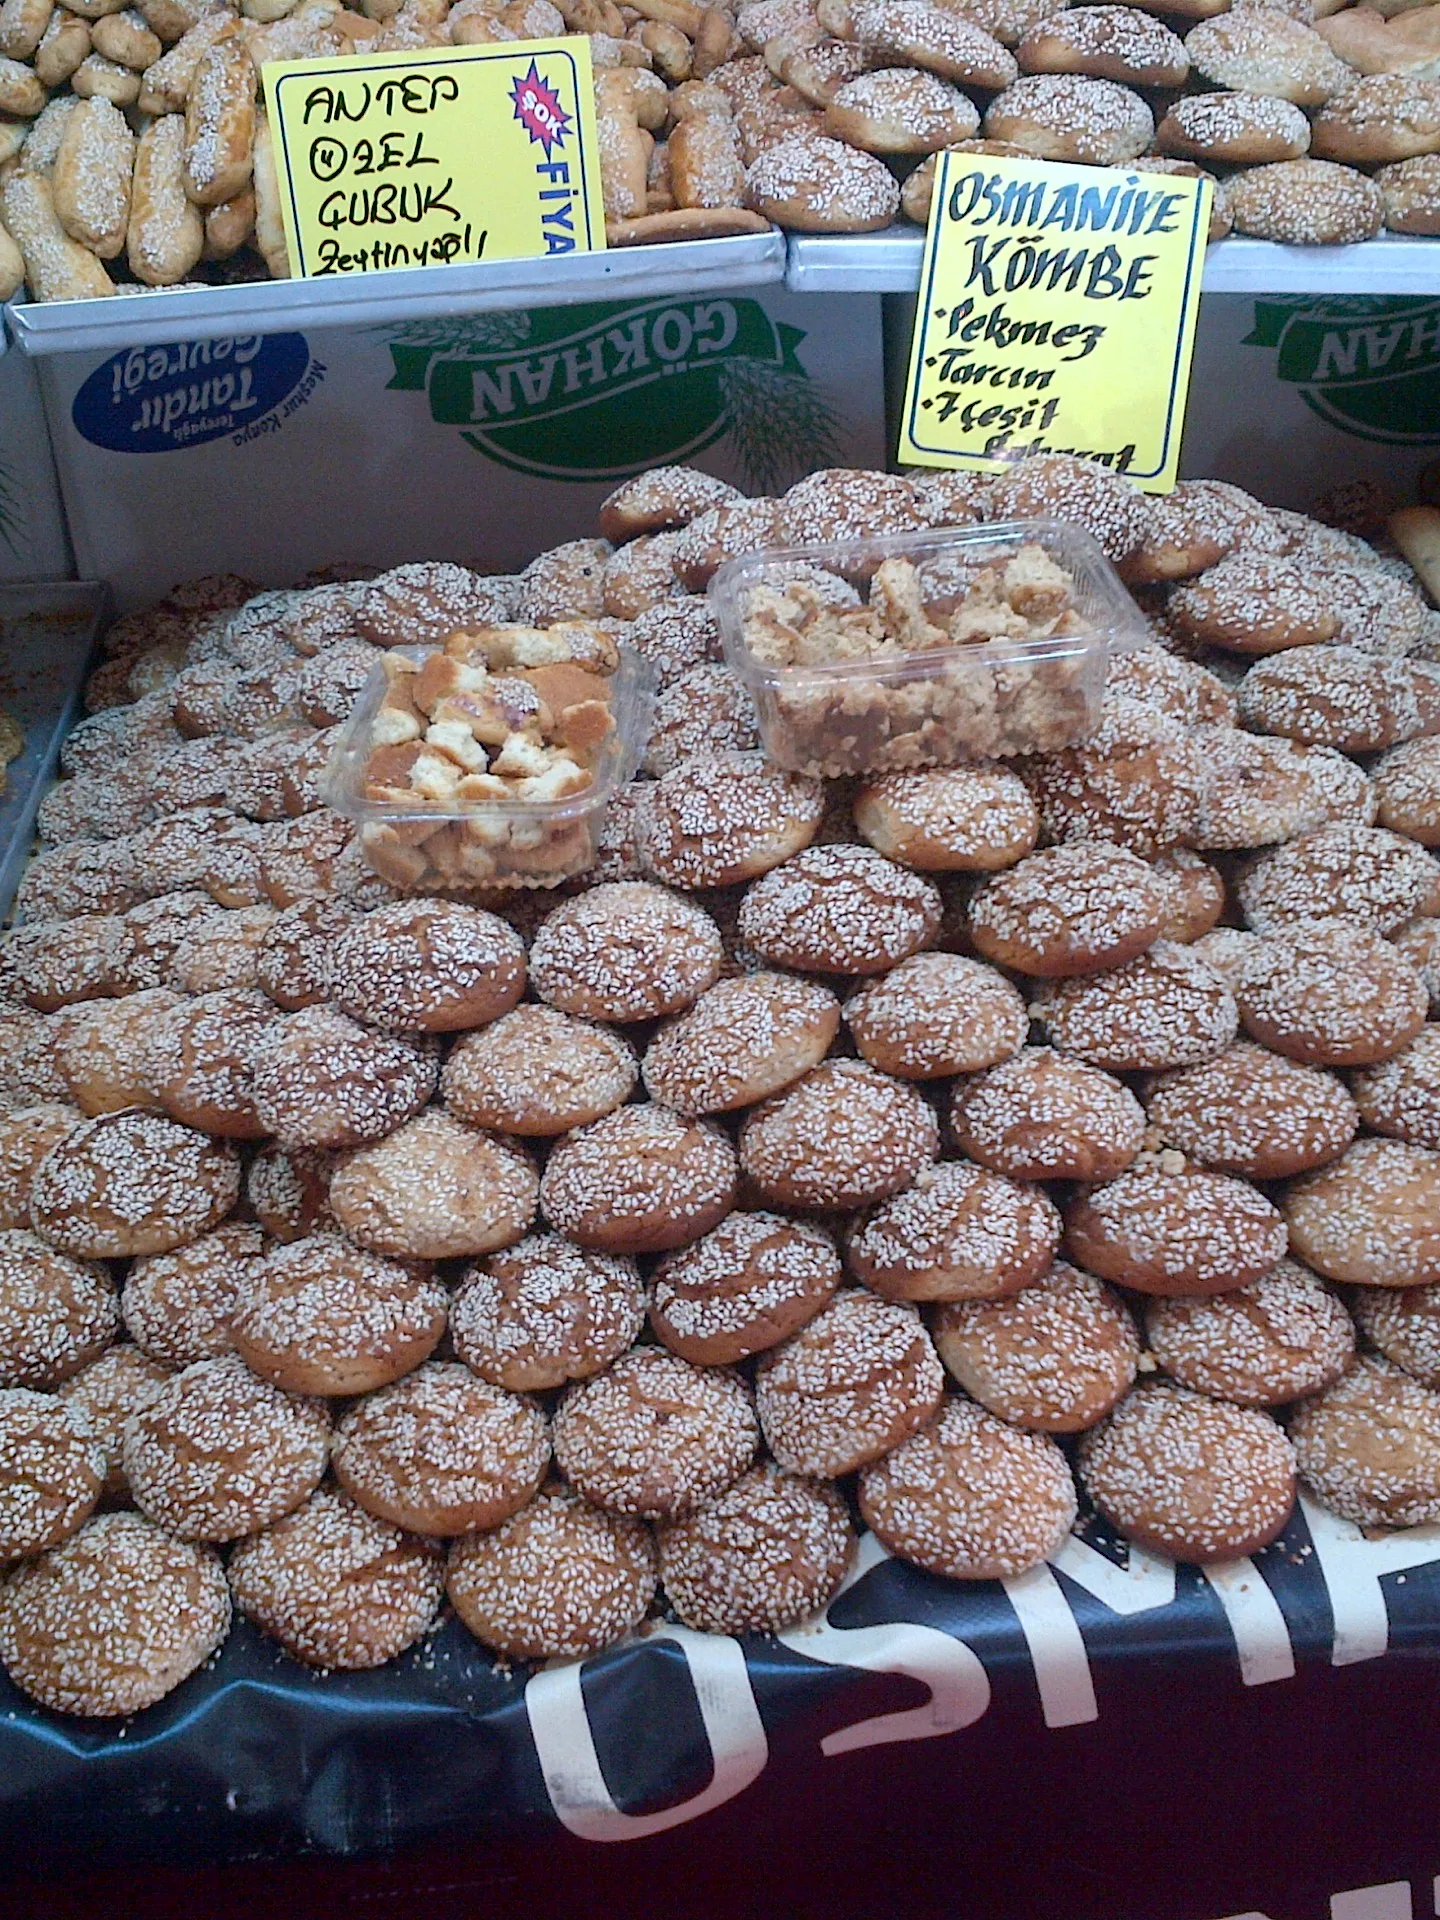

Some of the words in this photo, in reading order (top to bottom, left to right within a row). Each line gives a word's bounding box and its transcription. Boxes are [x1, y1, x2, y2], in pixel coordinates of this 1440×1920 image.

[303, 74, 459, 125] ANTEP
[317, 177, 462, 231] ÇUBUK
[948, 170, 1191, 236] OSMANİYE
[963, 233, 1160, 301] KÖMBE
[468, 299, 739, 421] GÖKHAN
[945, 297, 1107, 362] Pekmez
[131, 366, 258, 433] Tandır
